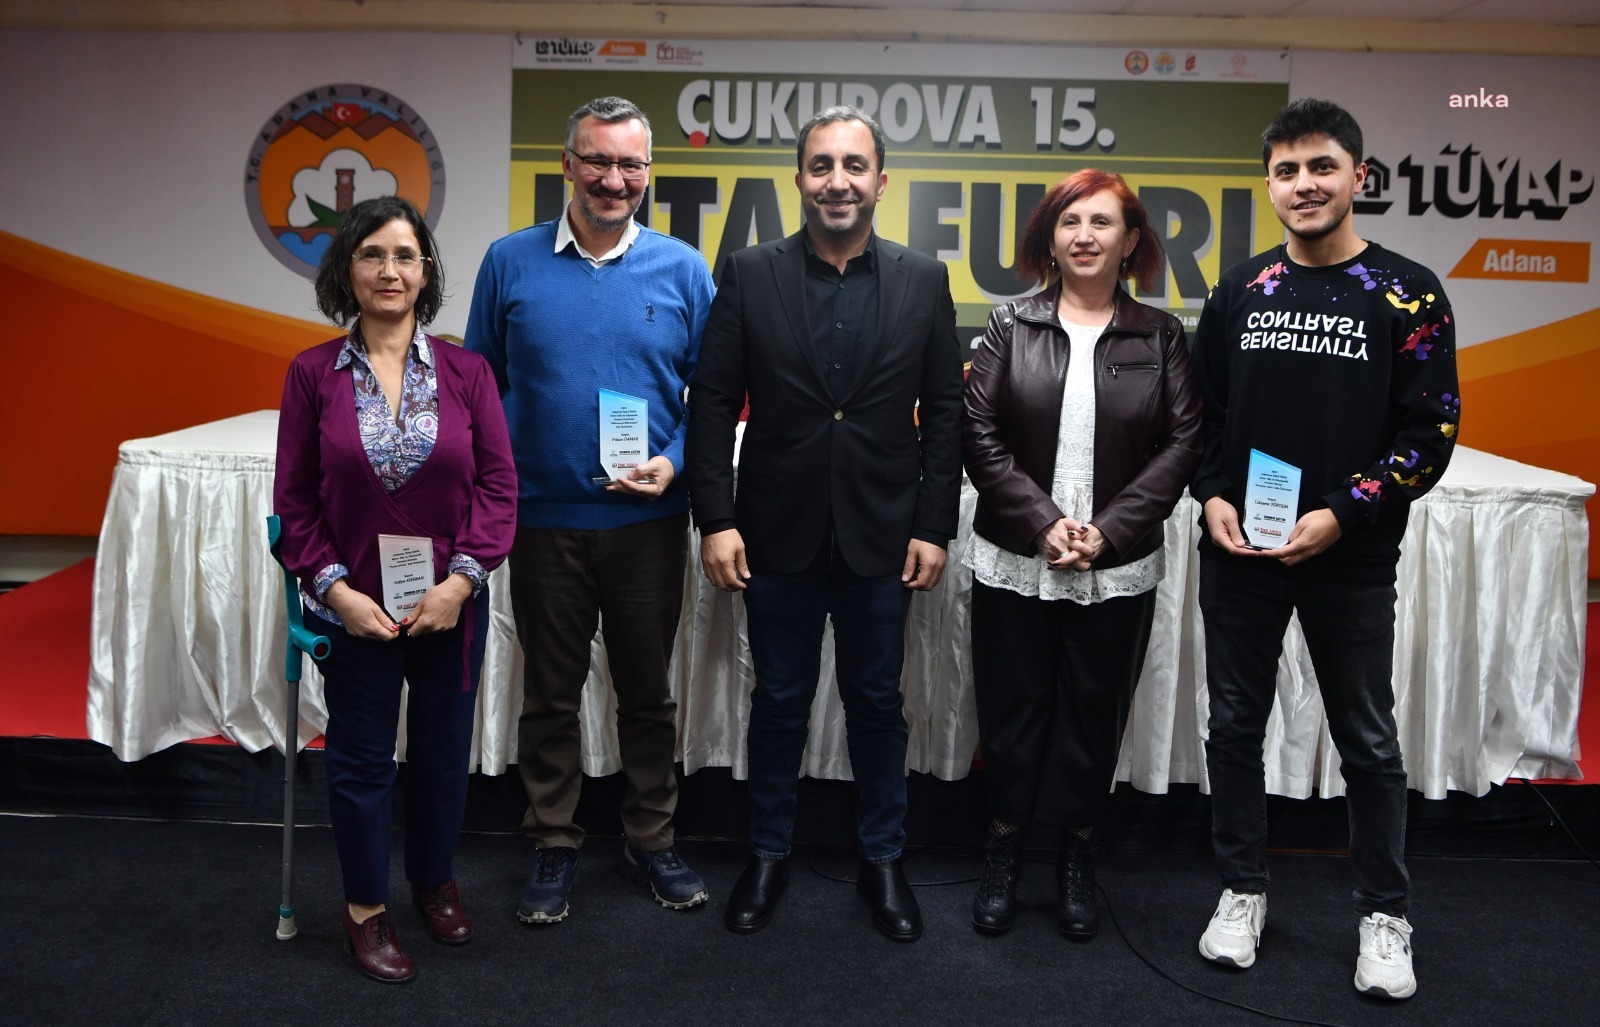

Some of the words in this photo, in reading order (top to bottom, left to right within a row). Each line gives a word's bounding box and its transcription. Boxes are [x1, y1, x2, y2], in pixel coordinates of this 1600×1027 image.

[260, 86, 338, 143] ADANA
[1030, 86, 1116, 149] 15.
[1397, 142, 1596, 221] TÜYAP
[1483, 249, 1557, 274] Adana
